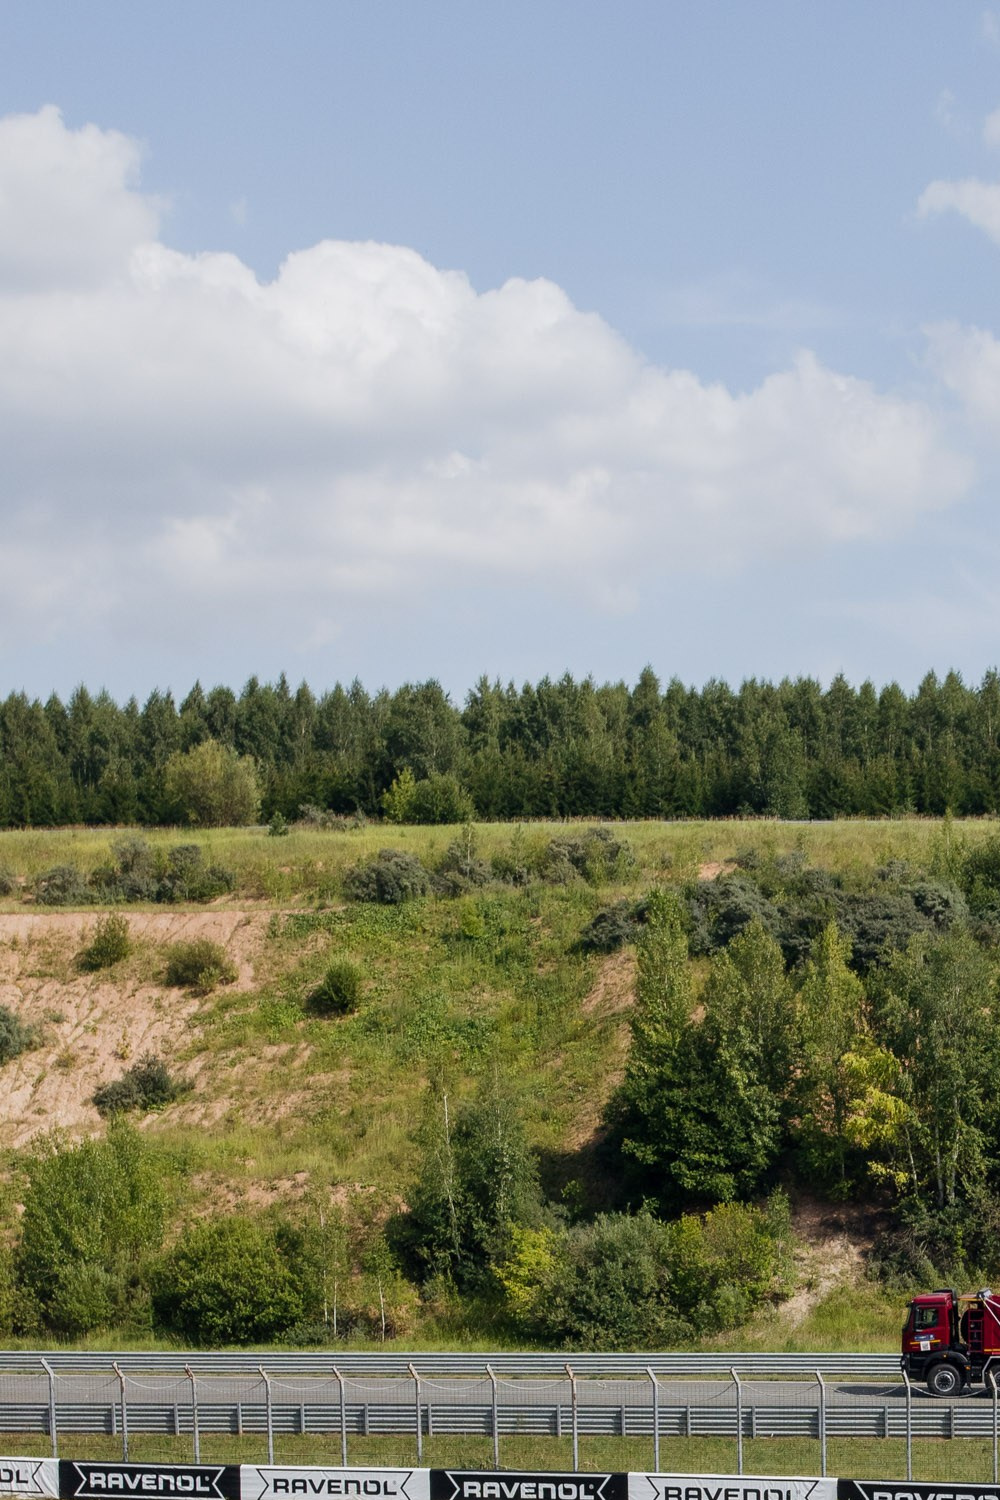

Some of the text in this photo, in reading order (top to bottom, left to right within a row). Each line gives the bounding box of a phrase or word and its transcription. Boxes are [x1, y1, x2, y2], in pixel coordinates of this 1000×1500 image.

[89, 1472, 210, 1492] RAVENOL
[273, 1478, 397, 1496] RAVENOL
[463, 1481, 595, 1500] RAVENOL
